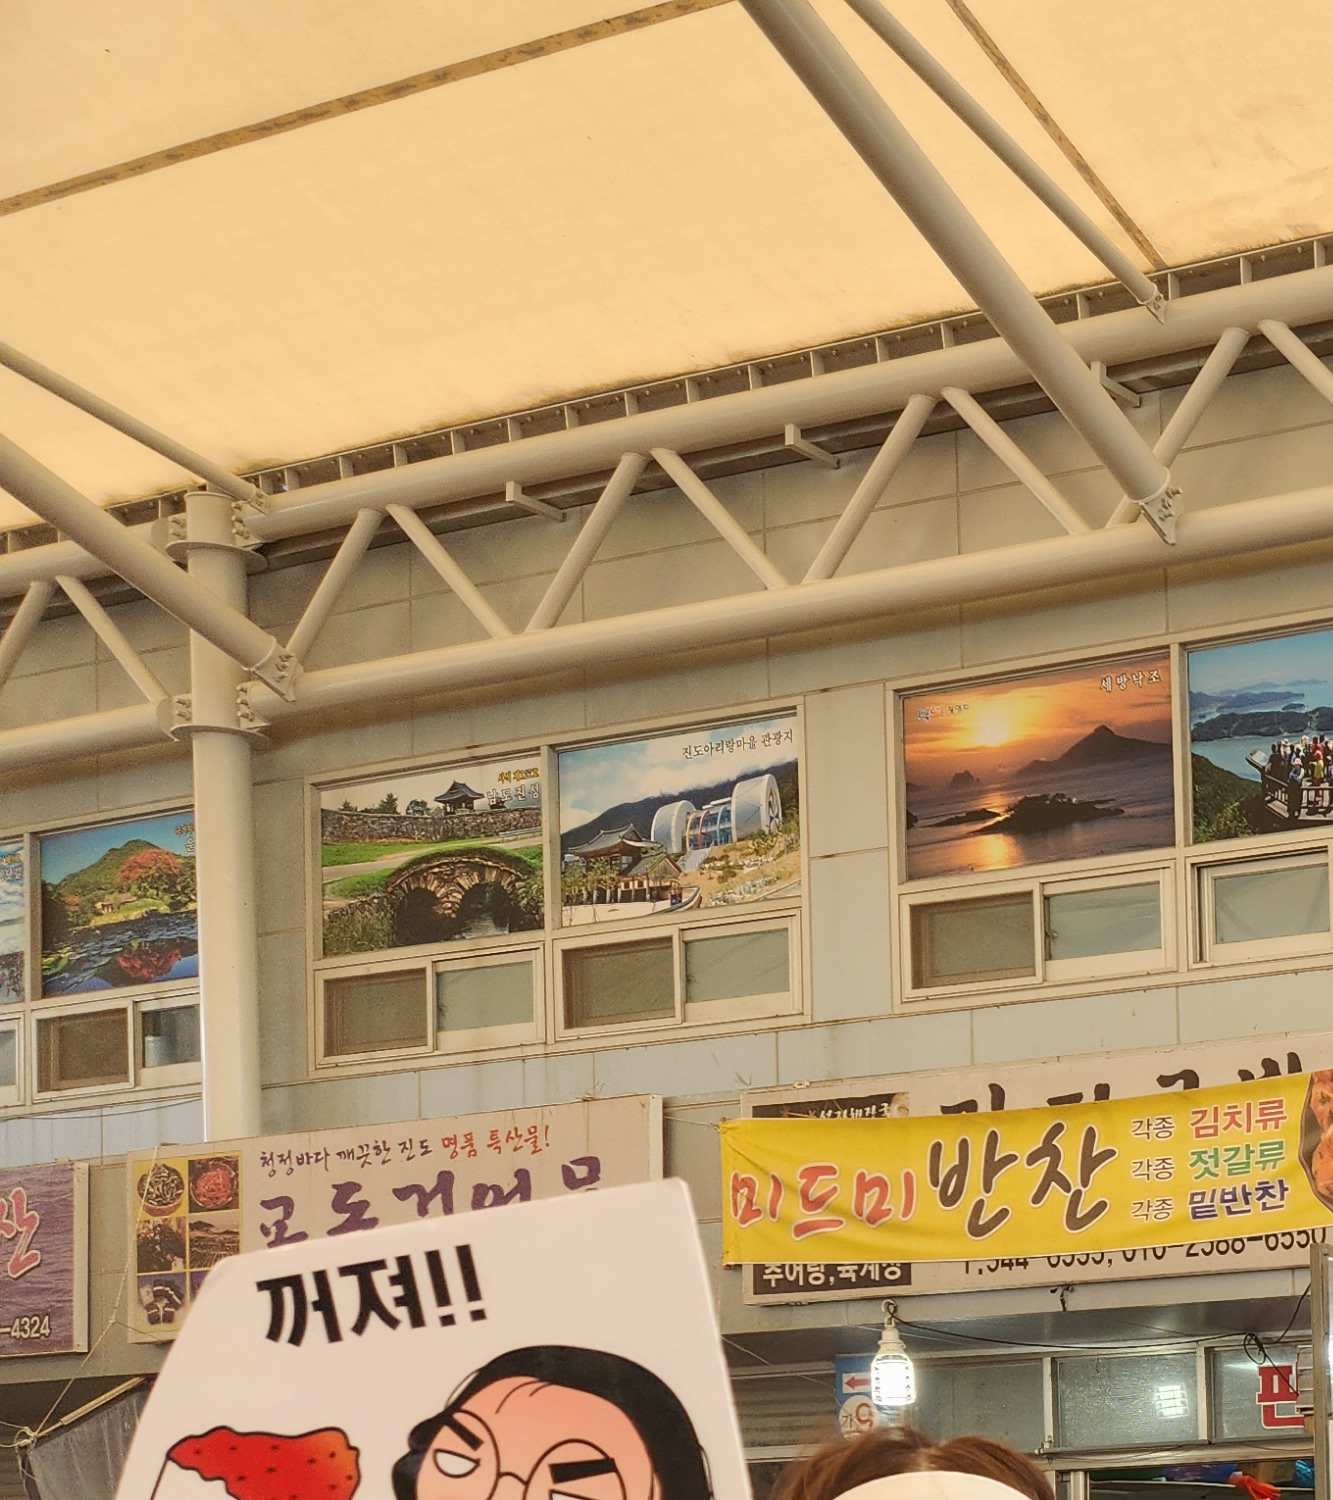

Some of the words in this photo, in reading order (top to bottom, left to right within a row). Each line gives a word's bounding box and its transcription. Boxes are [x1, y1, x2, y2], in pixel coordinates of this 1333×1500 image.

[1100, 669, 1161, 693] 세방낙조
[682, 734, 758, 760] 진도아리랑마을
[761, 728, 794, 748] 관광지
[1130, 1114, 1176, 1141] 각종
[1188, 1097, 1288, 1139] 김치류
[259, 1150, 329, 1177] 청정바다
[337, 1139, 392, 1169] 깨끗한
[398, 1138, 433, 1161] 진도
[442, 1131, 477, 1161] 명품
[486, 1124, 550, 1156] 특산물!
[1130, 1156, 1176, 1182] 각종
[1188, 1140, 1287, 1181] 젓갈류
[731, 1162, 917, 1241] 미드미
[927, 1119, 1120, 1239] 반찬
[1130, 1197, 1176, 1222] 각종
[1187, 1179, 1290, 1221] 밑반찬
[255, 1243, 488, 1347] 꺼져!!
